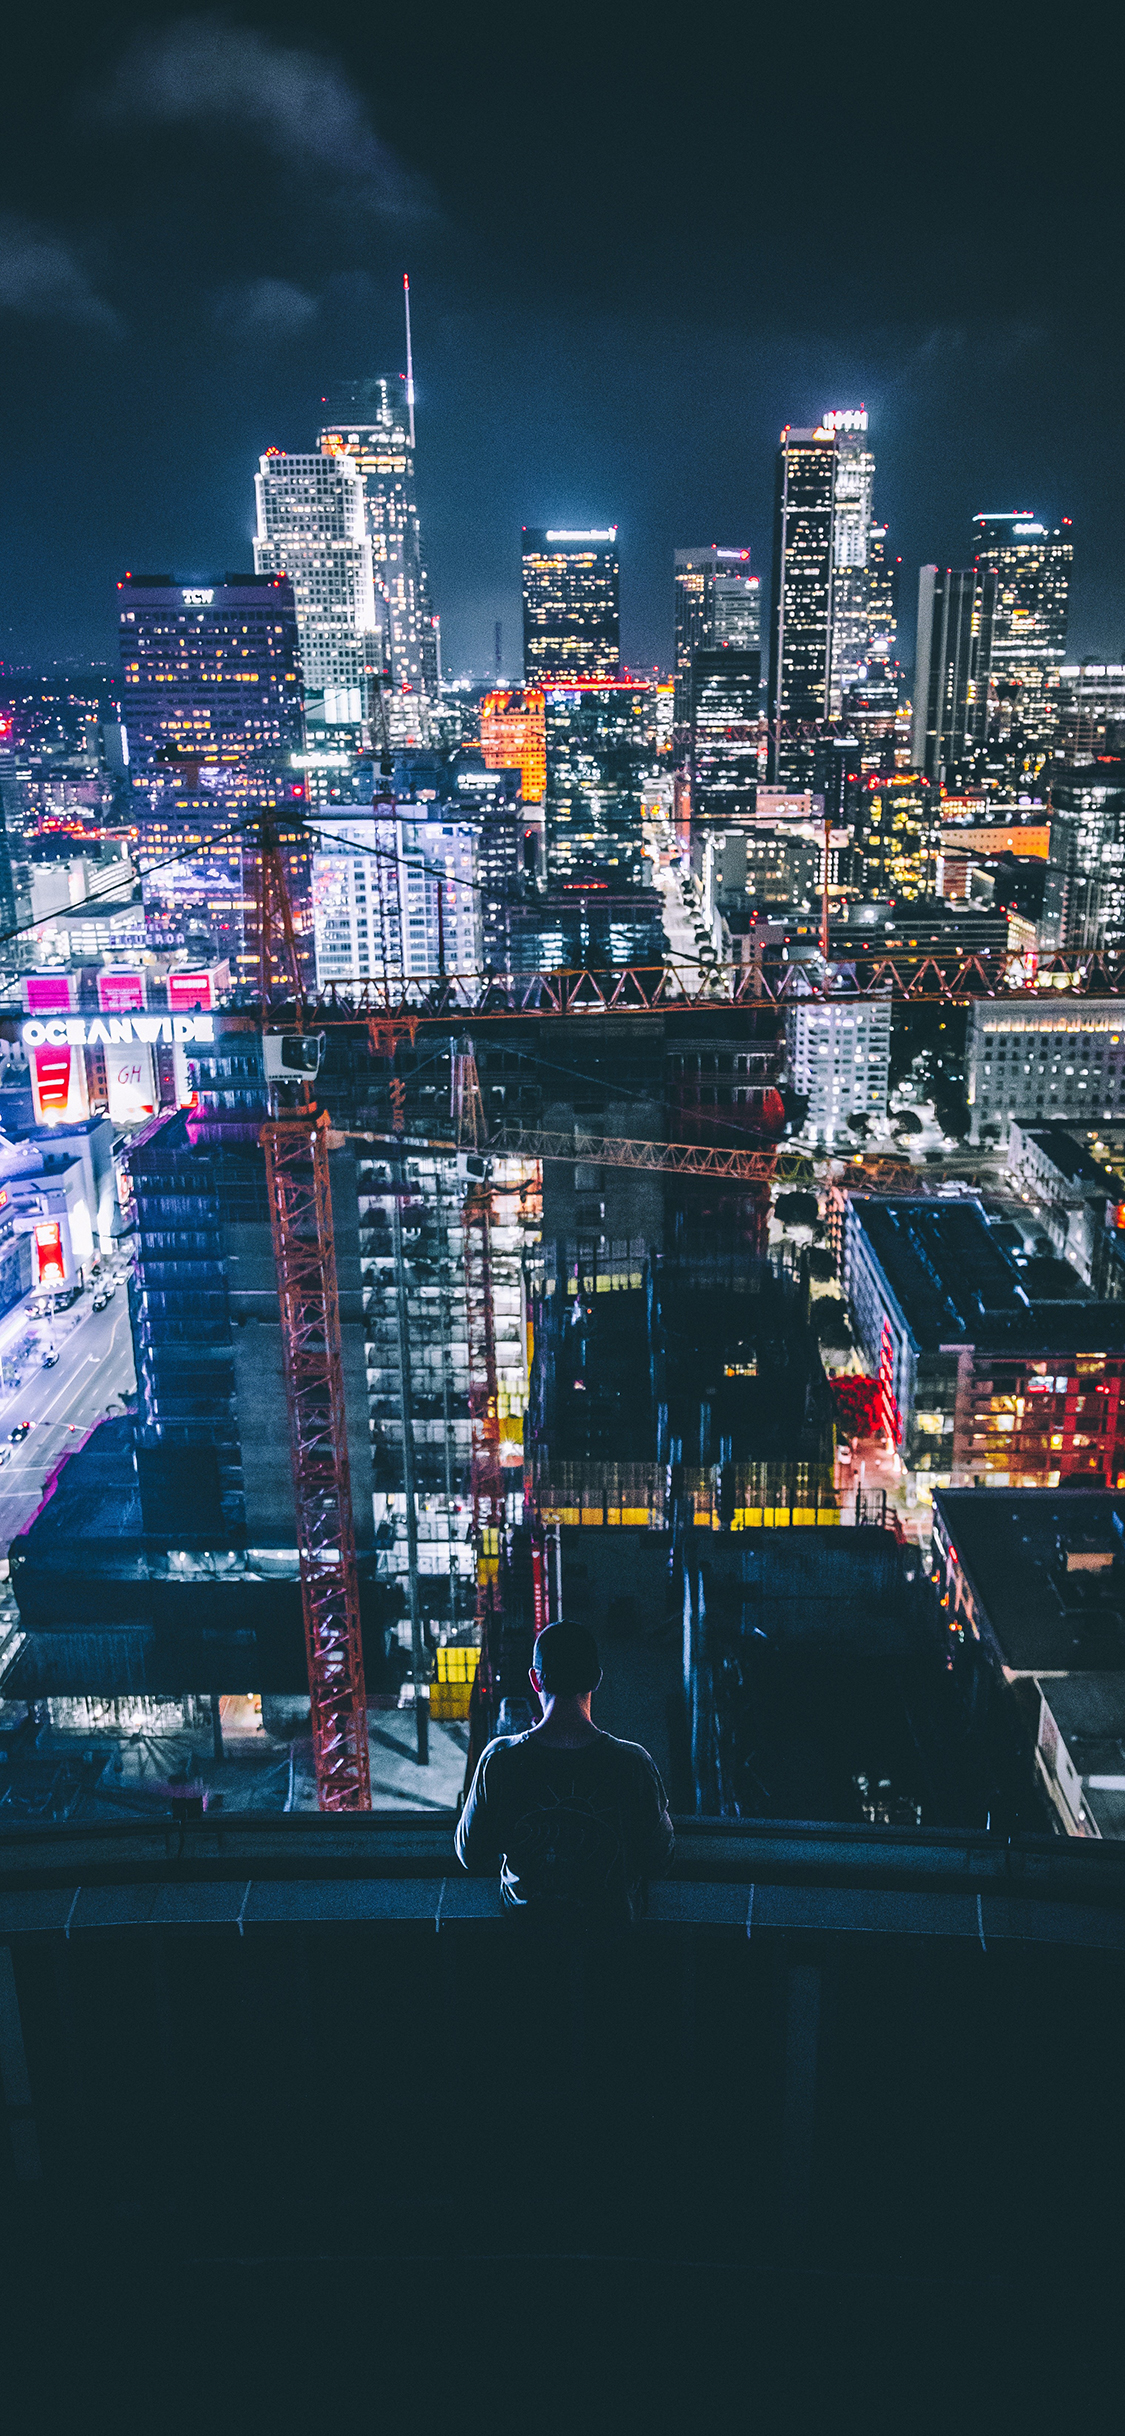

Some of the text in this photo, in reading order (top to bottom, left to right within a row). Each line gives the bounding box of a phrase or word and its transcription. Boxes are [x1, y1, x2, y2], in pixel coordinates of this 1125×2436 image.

[182, 589, 214, 604] TCW
[131, 923, 161, 931] TEL
[109, 933, 185, 945] FIGUEROA
[22, 1016, 214, 1046] OCEANWIDE
